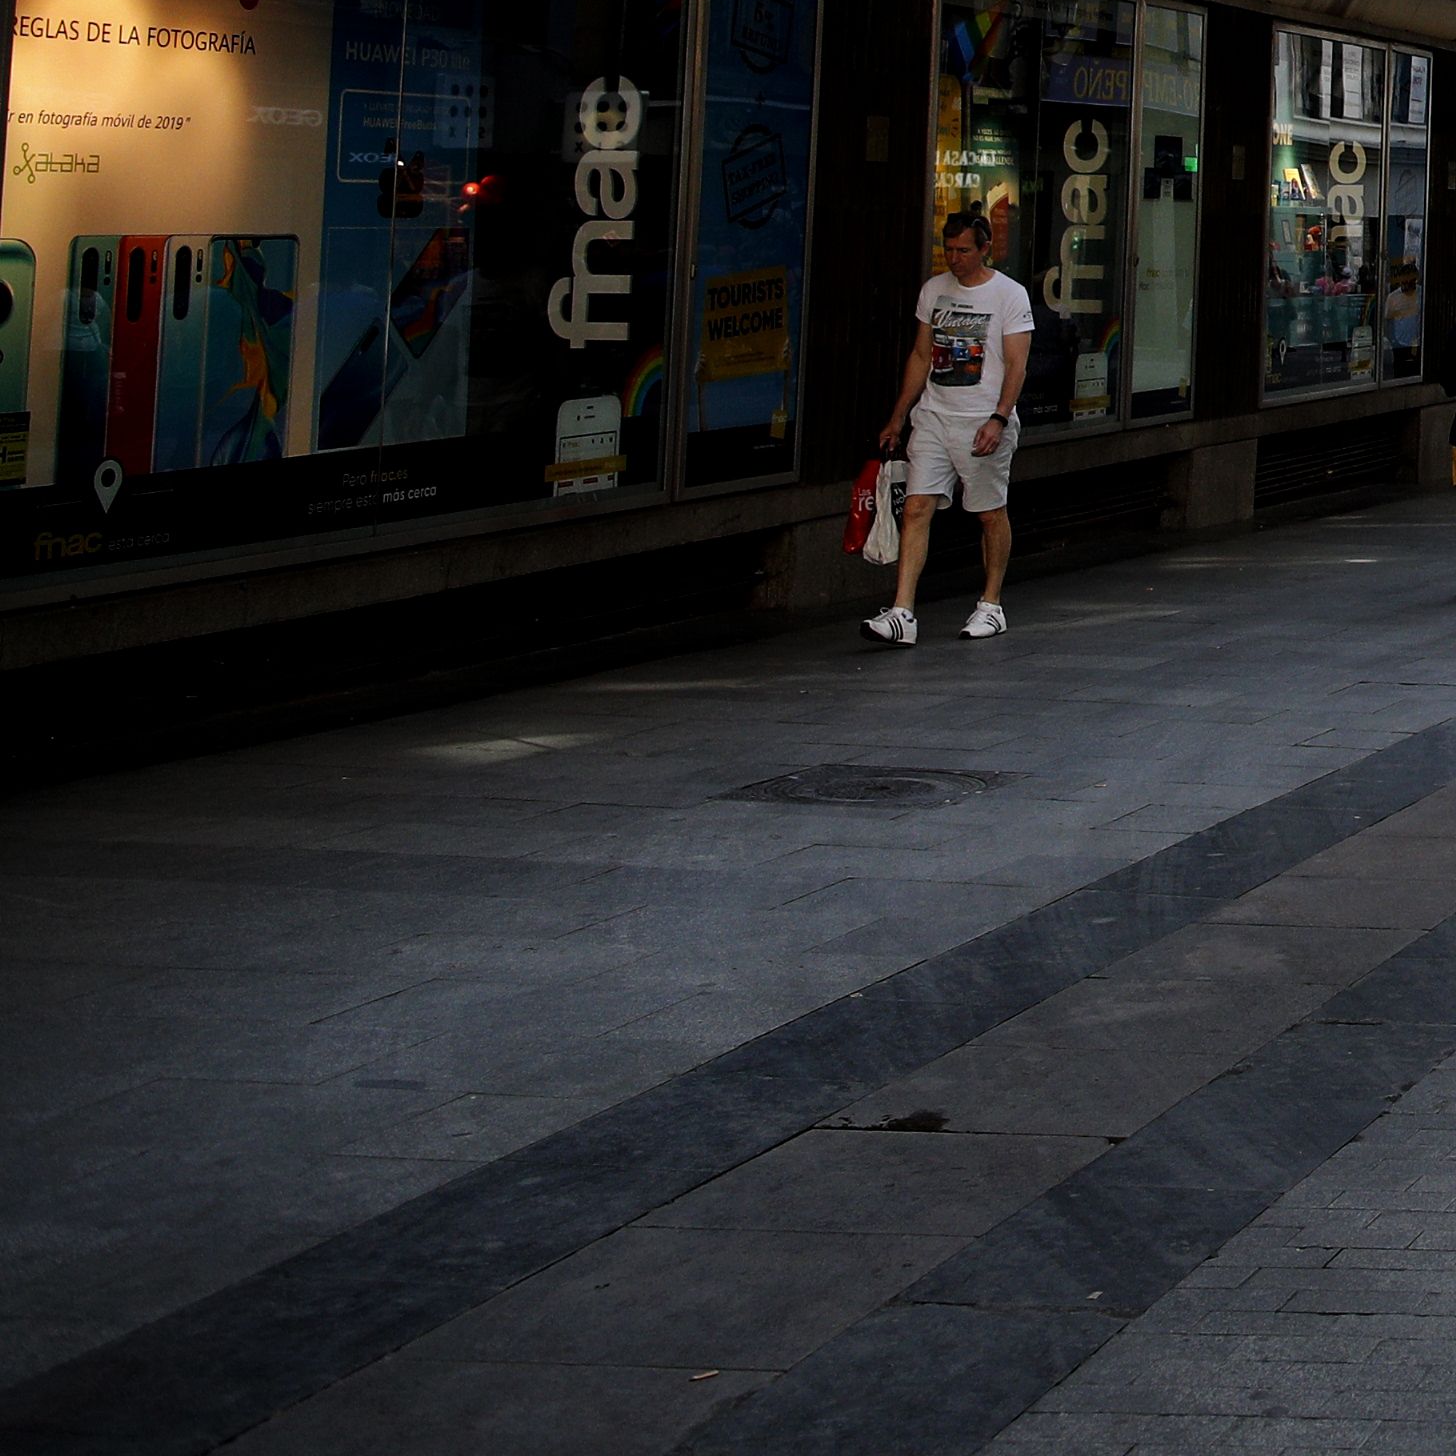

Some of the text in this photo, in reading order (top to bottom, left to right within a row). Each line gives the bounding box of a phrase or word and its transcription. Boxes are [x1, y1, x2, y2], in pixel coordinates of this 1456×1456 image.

[12, 16, 256, 55] REGLAS DE LA FOTOGRAFÍA
[345, 41, 416, 67] HUAWEI
[18, 112, 33, 124] en
[37, 110, 98, 129] fotografía
[101, 112, 134, 128] móvil
[137, 115, 152, 129] de
[547, 75, 644, 349] fnac
[1043, 117, 1110, 319] fnac
[707, 277, 784, 311] TOURISTS
[707, 307, 784, 341] WELCOME
[382, 488, 405, 504] más
[407, 485, 437, 500] cerca
[33, 531, 103, 561] fnac
